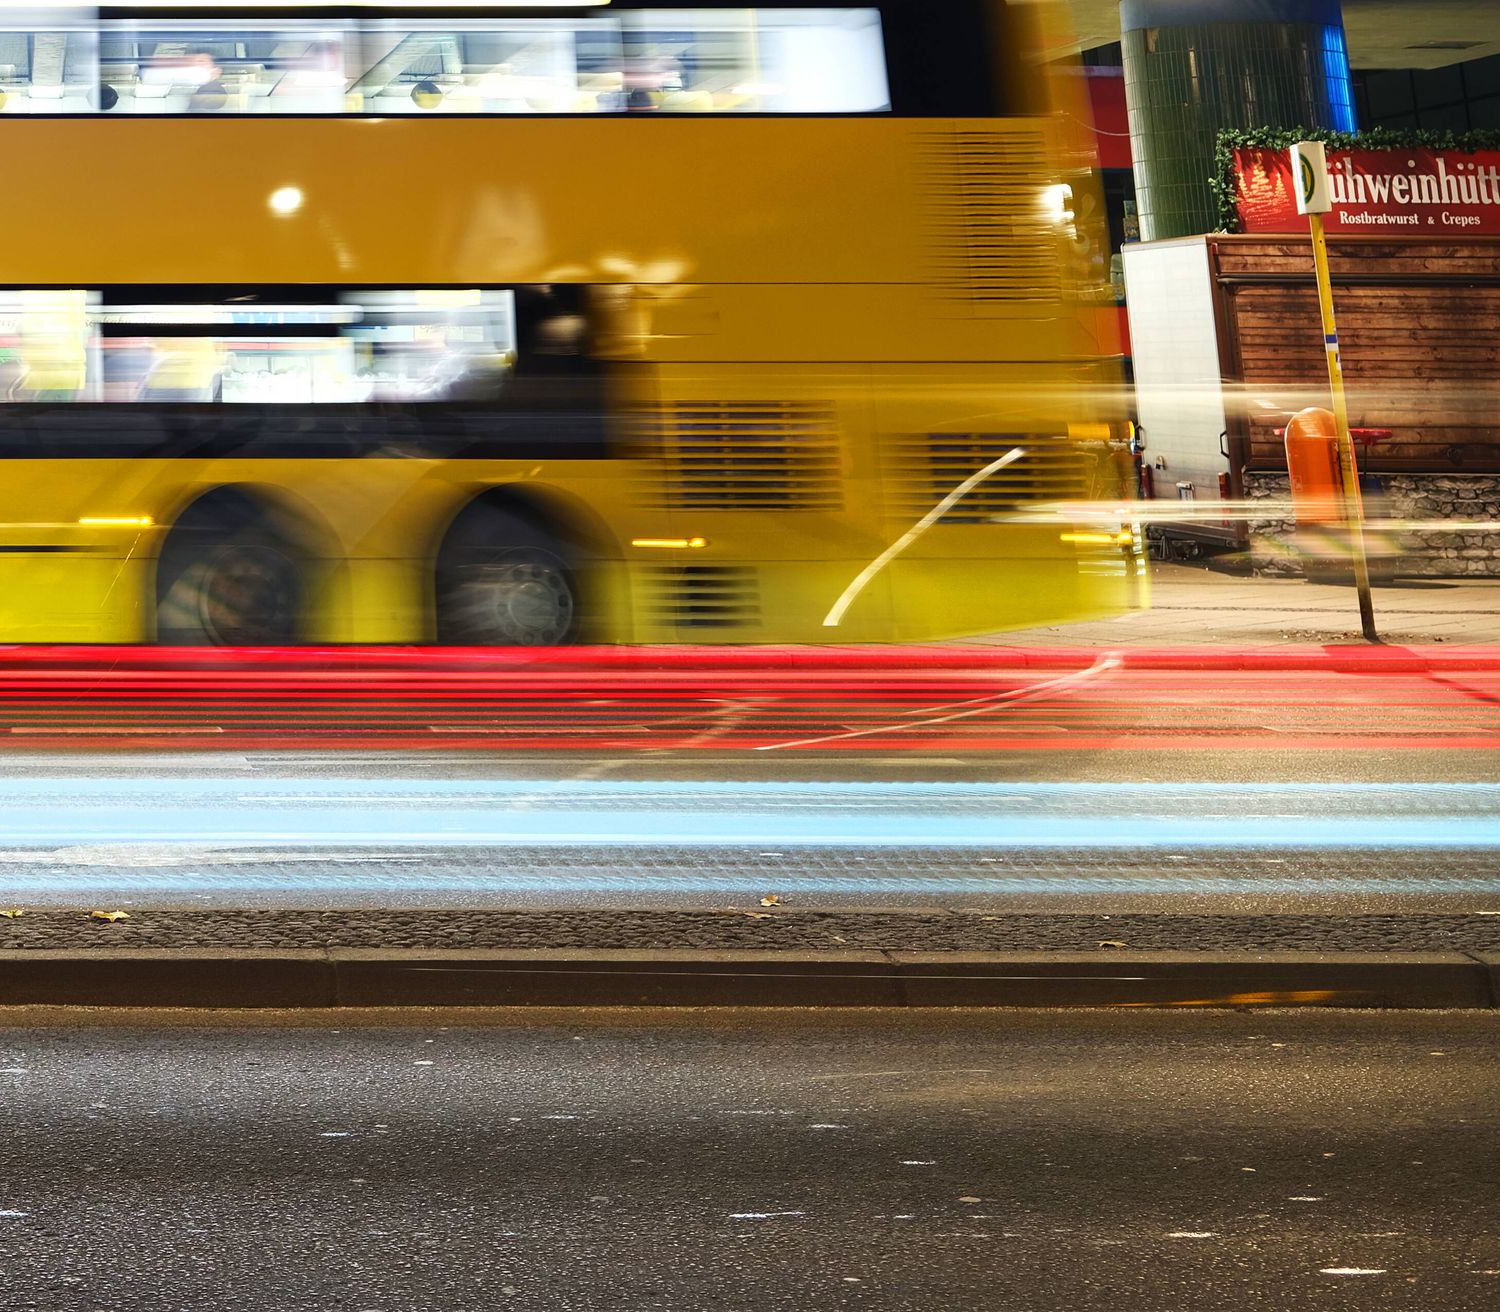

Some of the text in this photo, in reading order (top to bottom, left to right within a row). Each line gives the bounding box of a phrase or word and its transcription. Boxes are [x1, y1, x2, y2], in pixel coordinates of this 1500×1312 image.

[1339, 210, 1481, 227] Rostbratwurst & Crepes
